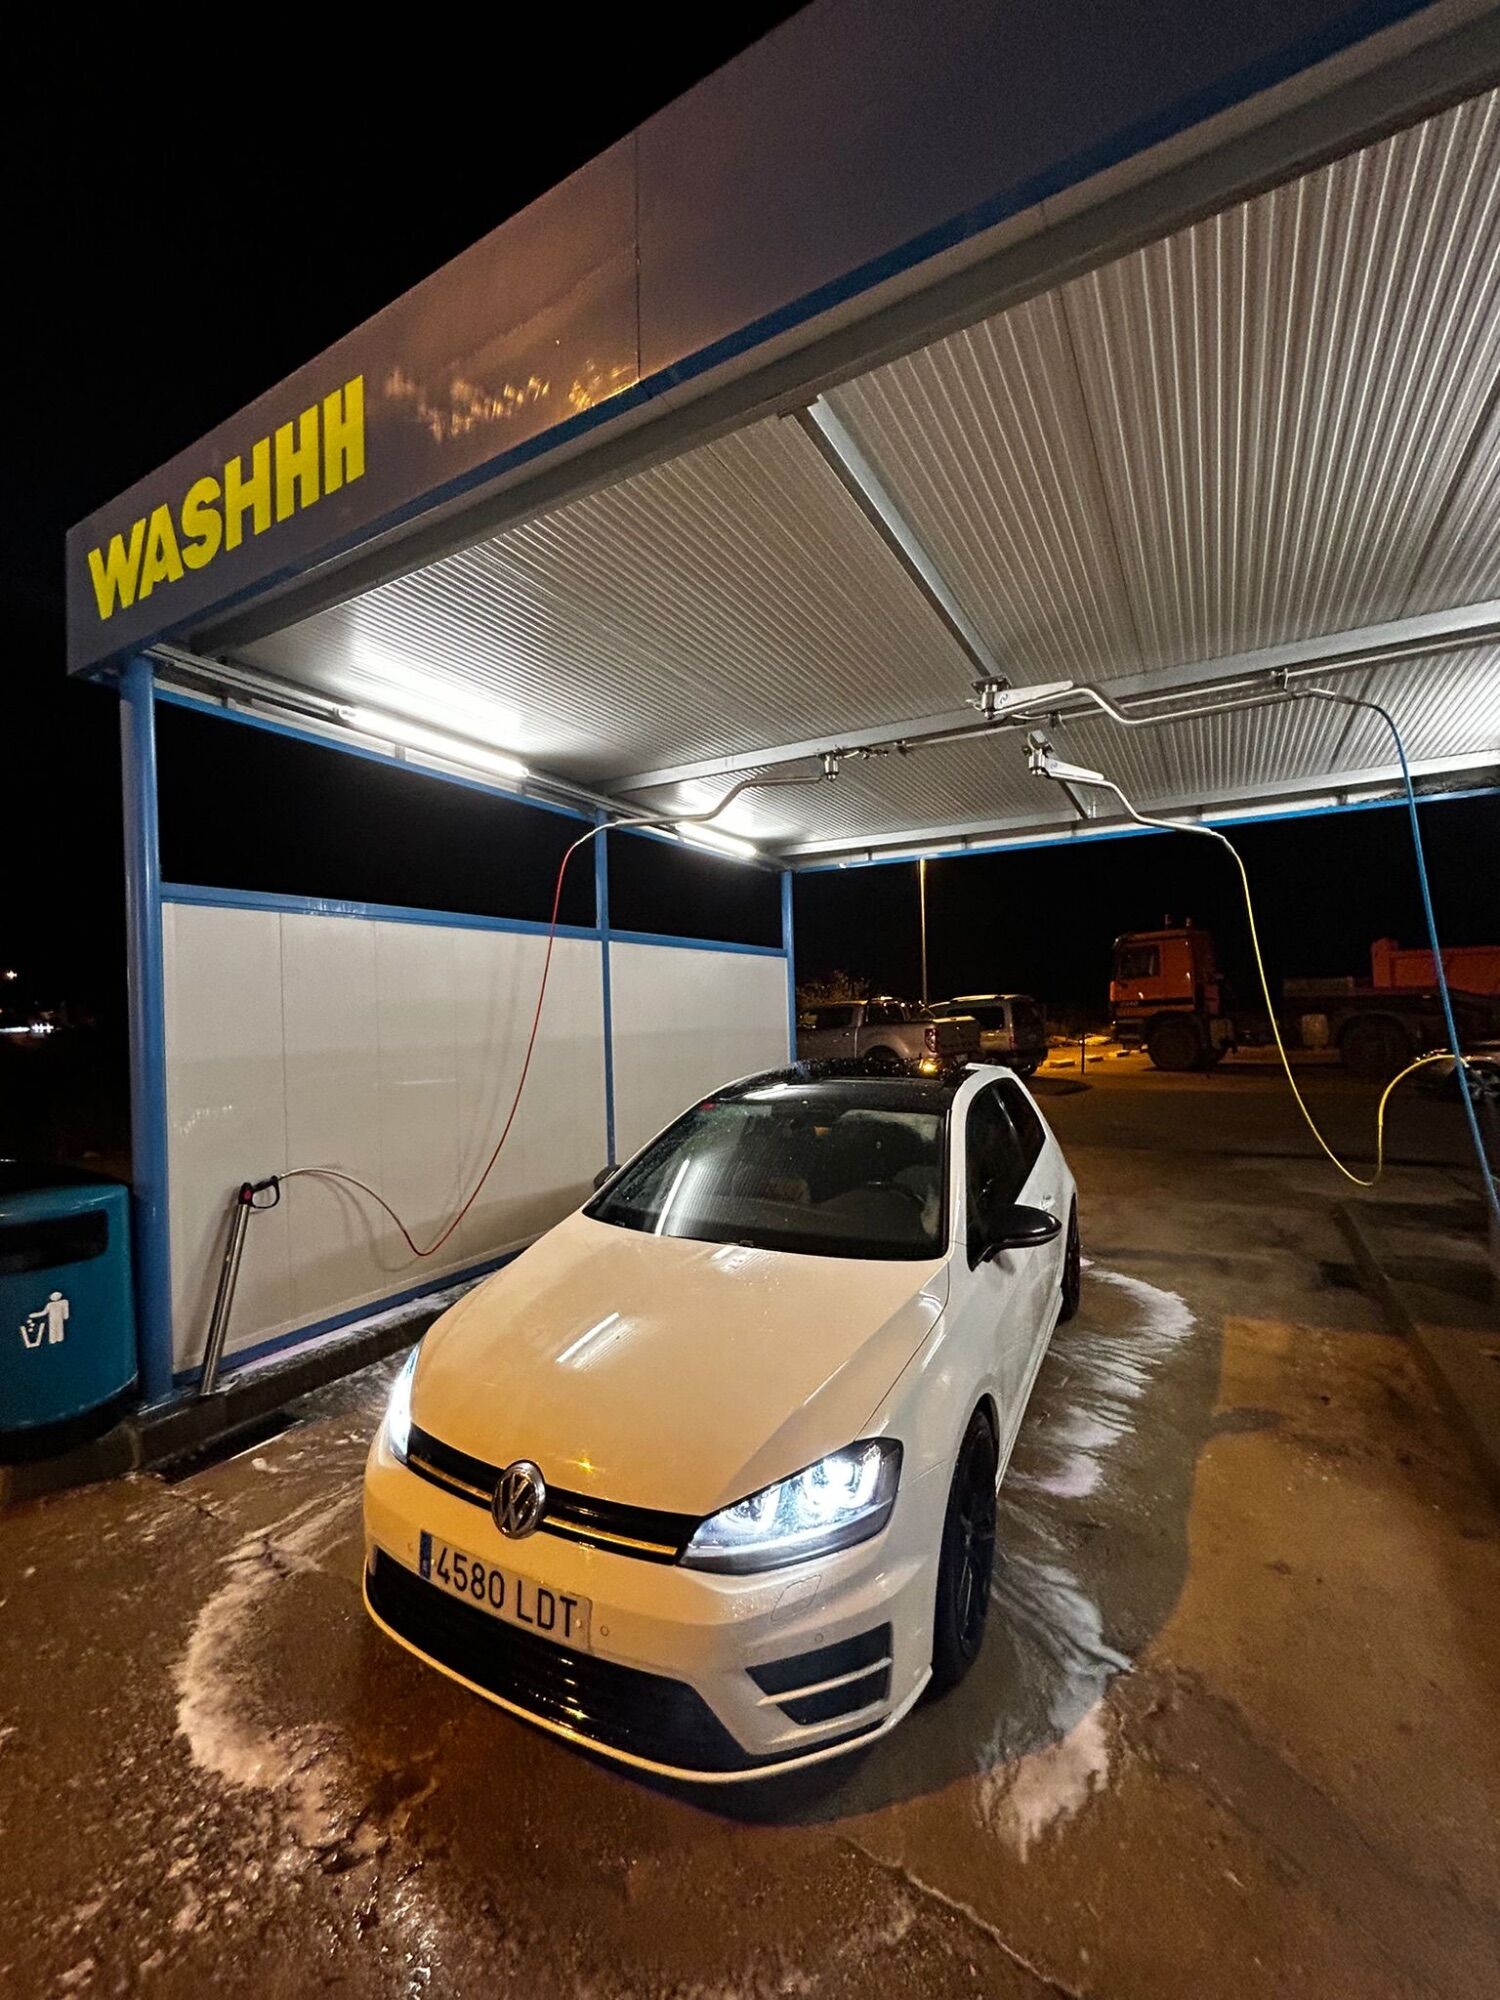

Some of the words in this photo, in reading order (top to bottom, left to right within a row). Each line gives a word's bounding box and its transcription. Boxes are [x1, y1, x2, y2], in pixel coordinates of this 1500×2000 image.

[88, 375, 365, 620] WASHHH
[437, 1547, 504, 1608] 4580
[516, 1579, 577, 1637] LDT
